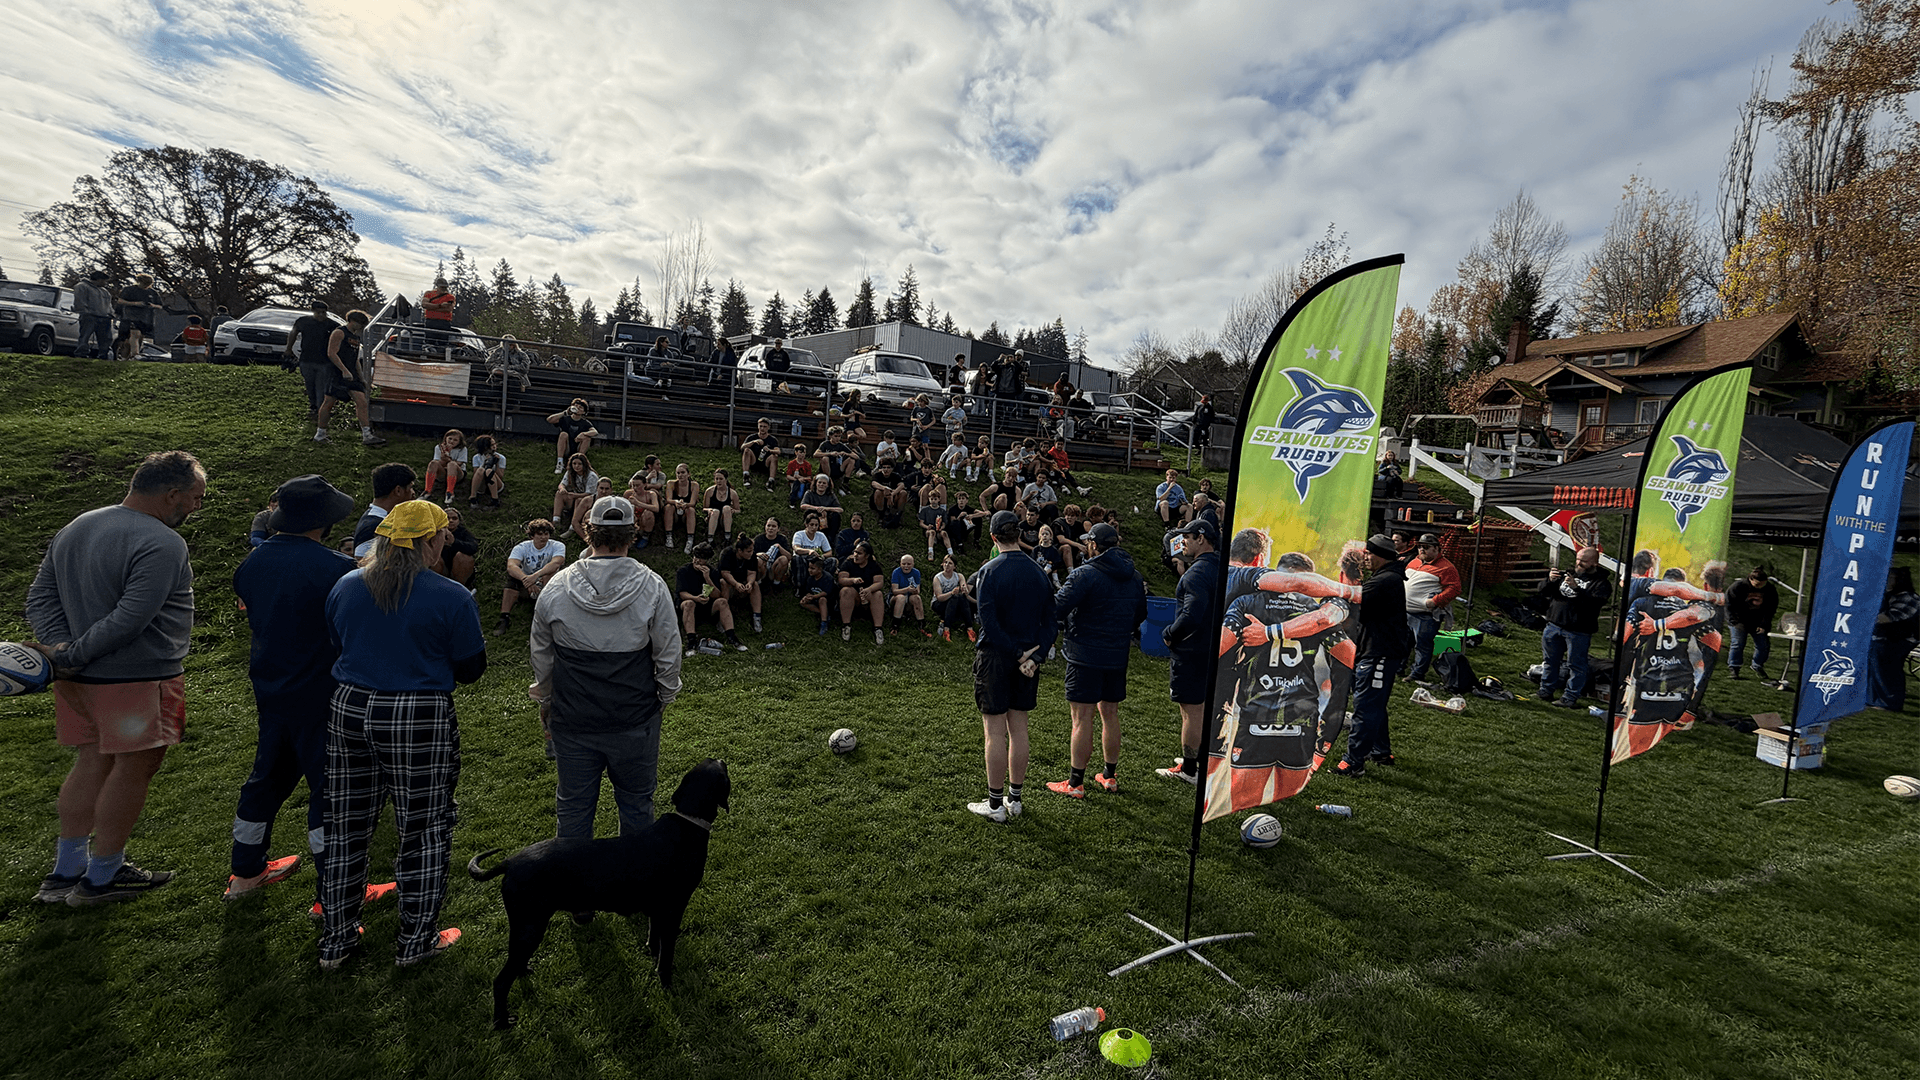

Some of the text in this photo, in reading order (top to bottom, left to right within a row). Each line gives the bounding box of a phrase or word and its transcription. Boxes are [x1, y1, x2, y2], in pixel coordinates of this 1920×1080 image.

[1255, 429, 1370, 452] SEAWOLVES
[1276, 446, 1340, 463] RUGBY
[1648, 478, 1725, 498] SEAWOLVES
[1855, 442, 1883, 517] RUN
[1663, 491, 1708, 504] RUGBY
[1835, 515, 1886, 533] WITH THE
[1765, 529, 1820, 539] CHINOO
[1896, 535, 1920, 544] LA
[1833, 533, 1865, 634] PACK
[1655, 628, 1678, 650] 15
[1269, 638, 1303, 667] 15
[1272, 675, 1305, 689] Tukwila
